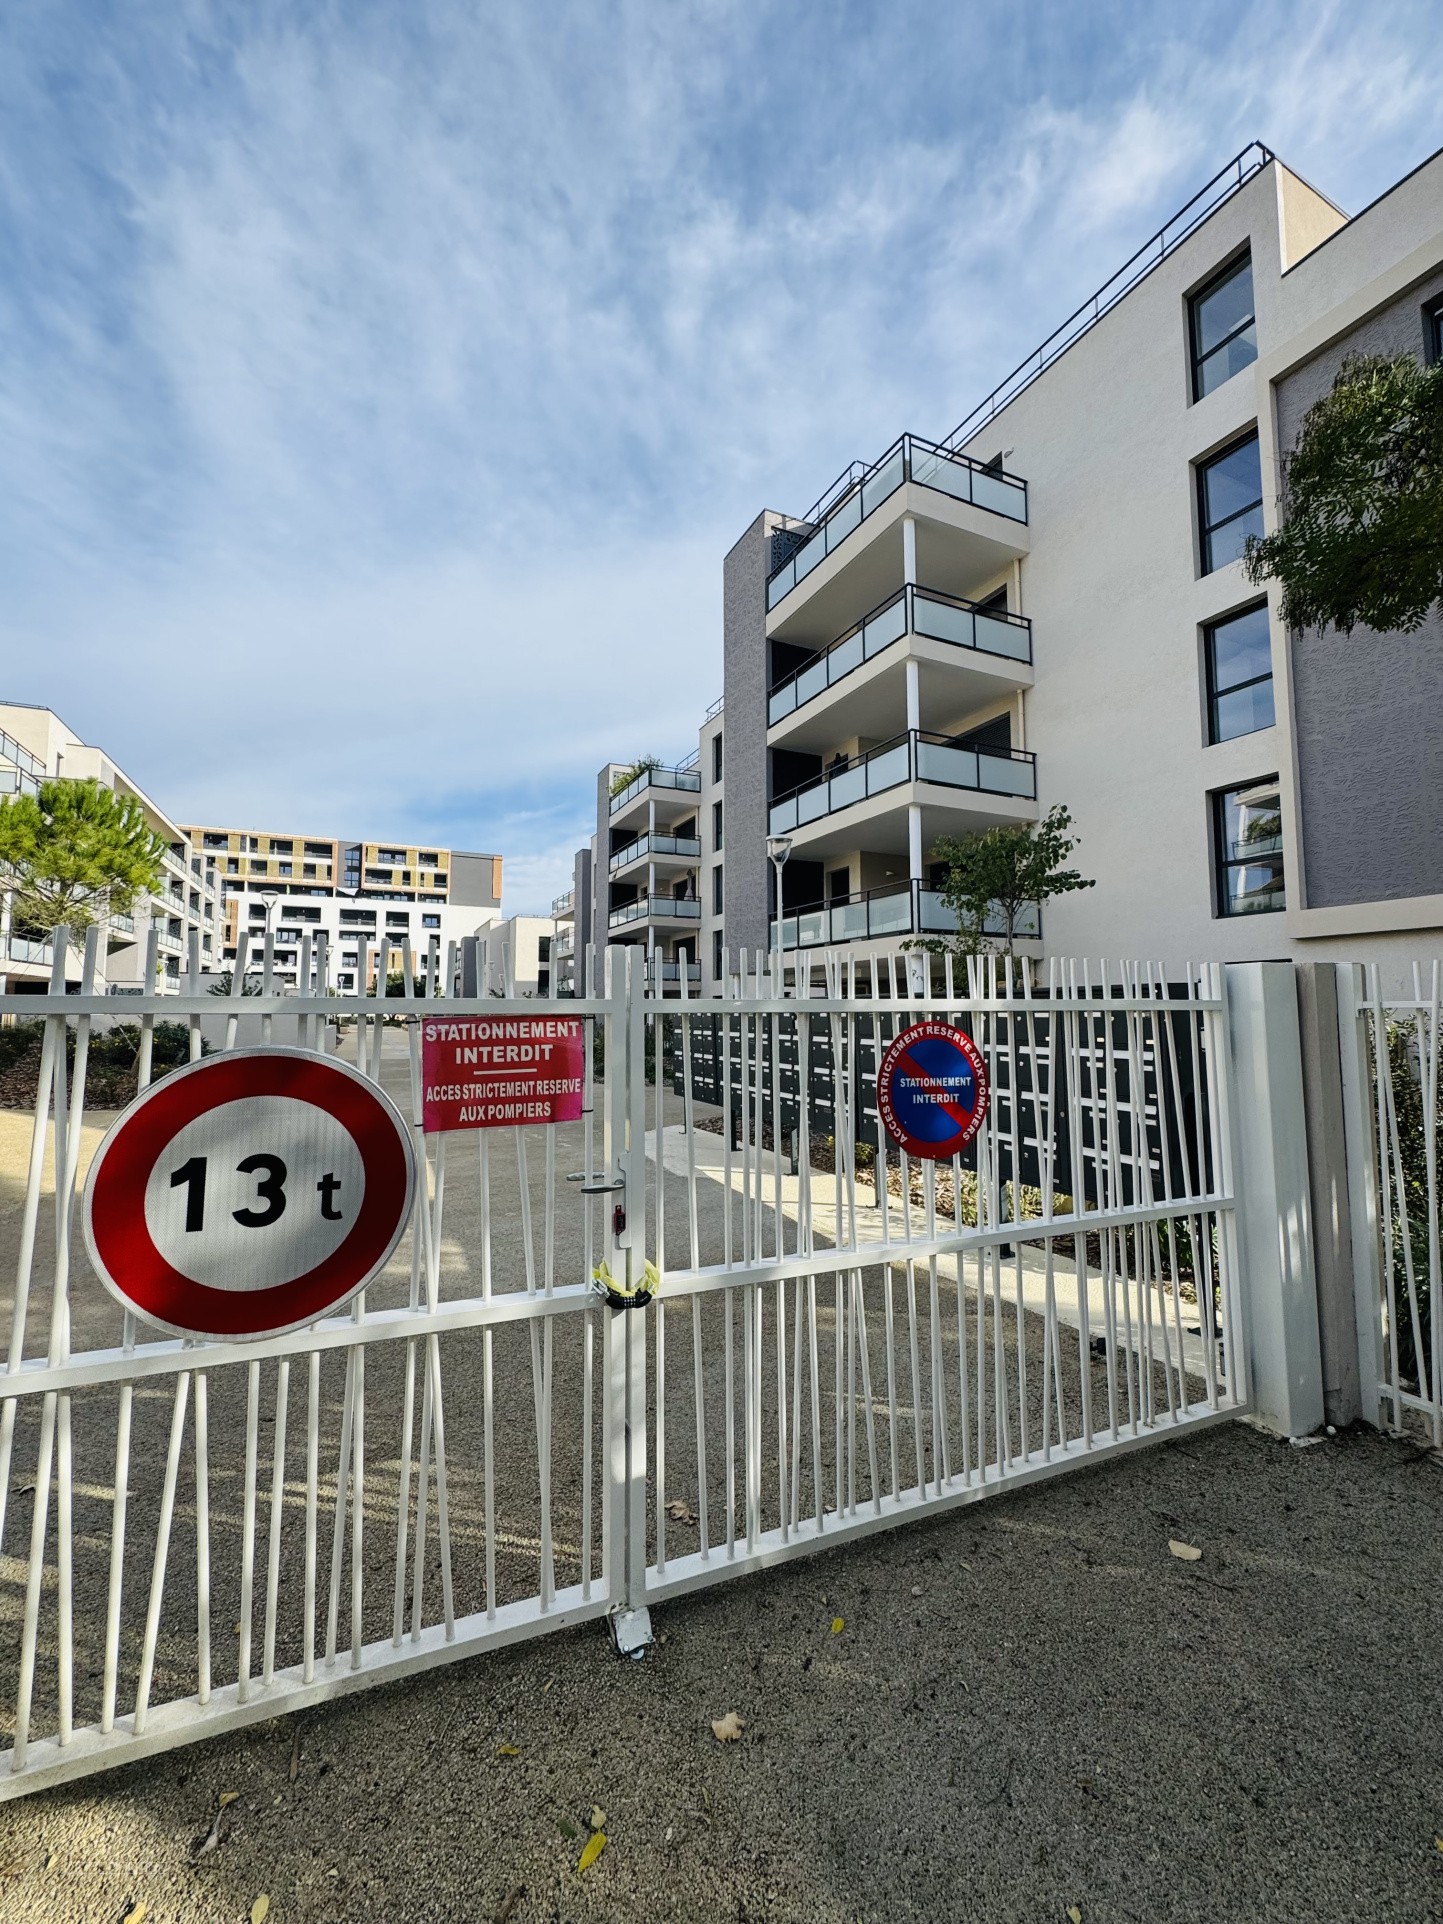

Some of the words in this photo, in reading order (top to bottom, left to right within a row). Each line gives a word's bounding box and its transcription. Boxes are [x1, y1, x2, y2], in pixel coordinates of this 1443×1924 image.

[425, 1021, 579, 1042] STATIONNEMENT
[926, 1025, 972, 1053] RESERVE
[455, 1044, 553, 1064] INTERDIT
[880, 1027, 924, 1103] STRICTEMENT
[969, 1052, 984, 1077] AUX
[426, 1084, 461, 1102] ACCES
[462, 1080, 534, 1099] STRICTEMENT
[536, 1078, 581, 1096] RESERVE
[900, 1077, 972, 1087] STATIONNEMENT
[912, 1093, 960, 1104] INTERDIT
[962, 1078, 986, 1140] POMPIERS
[459, 1105, 486, 1122] AUX
[488, 1101, 551, 1119] POMPIERS
[882, 1105, 908, 1143] ACCES
